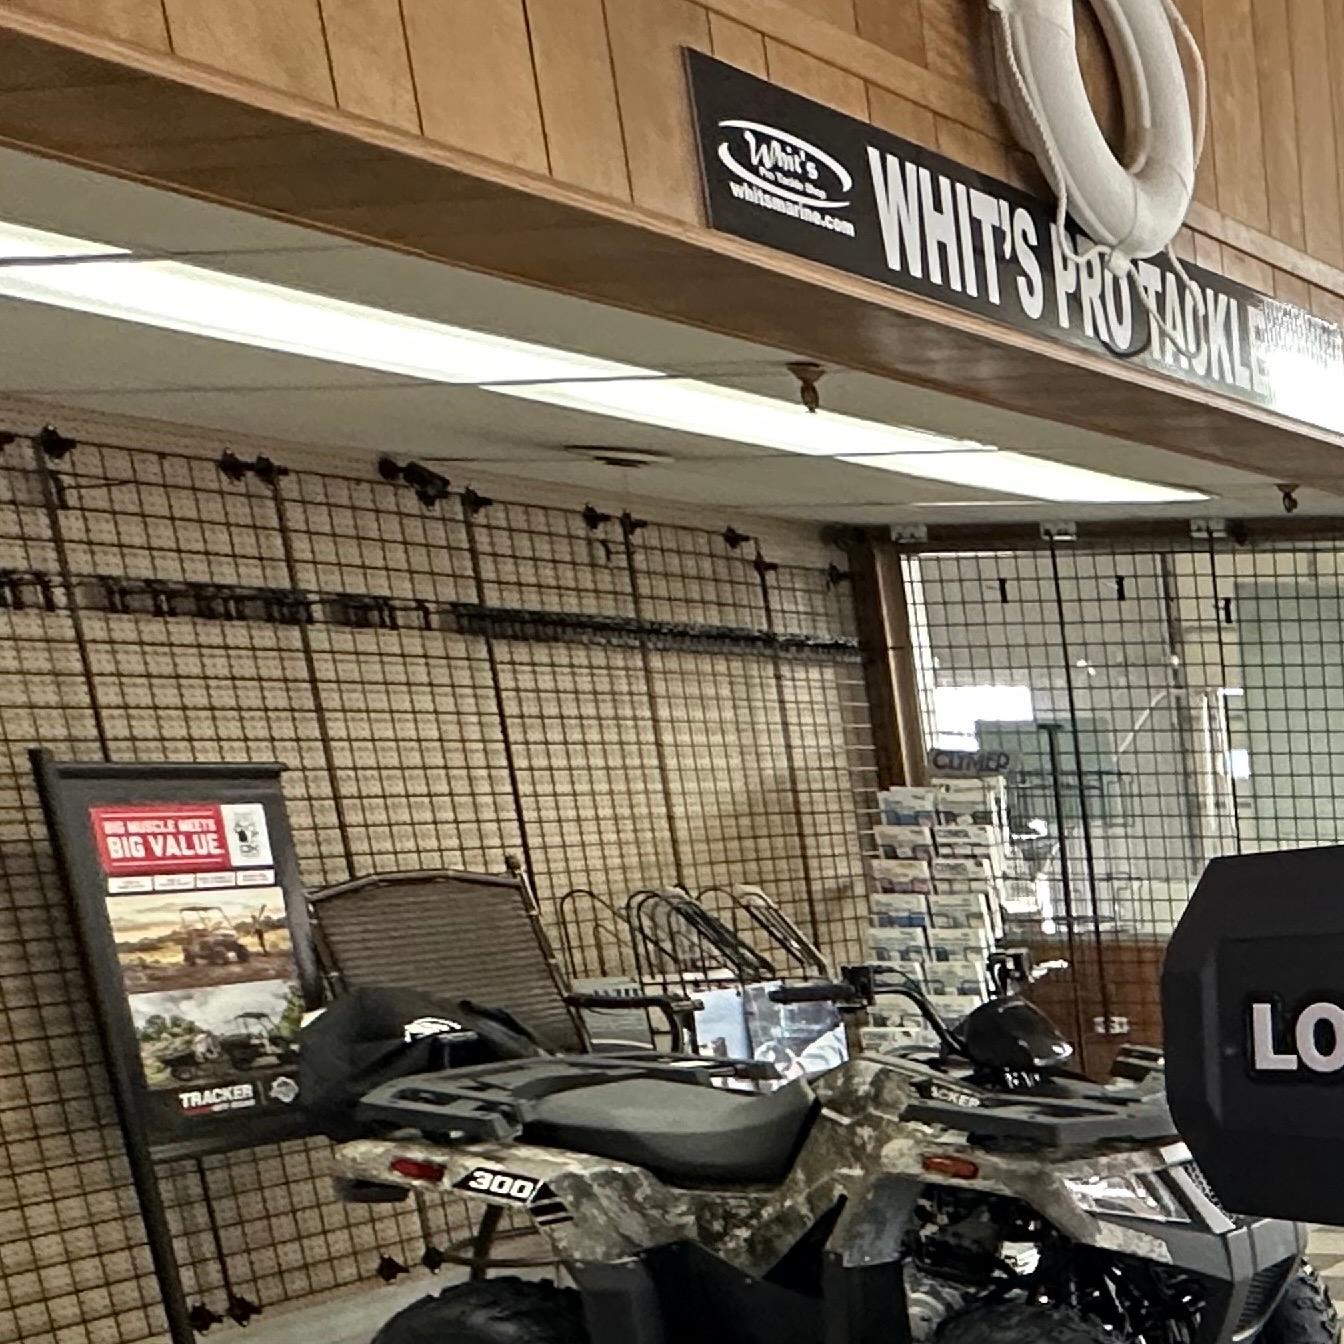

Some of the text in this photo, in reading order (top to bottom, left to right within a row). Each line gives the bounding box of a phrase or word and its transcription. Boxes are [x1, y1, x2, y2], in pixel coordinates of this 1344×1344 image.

[744, 130, 819, 180] Whit's
[729, 180, 857, 238] whitsmarine.com
[866, 146, 1271, 396] WHIT'S PRO TACKLE
[106, 835, 146, 859] BIG
[150, 832, 225, 857] VALUE
[179, 1084, 254, 1108] TRACKER
[469, 1171, 533, 1198] 300
